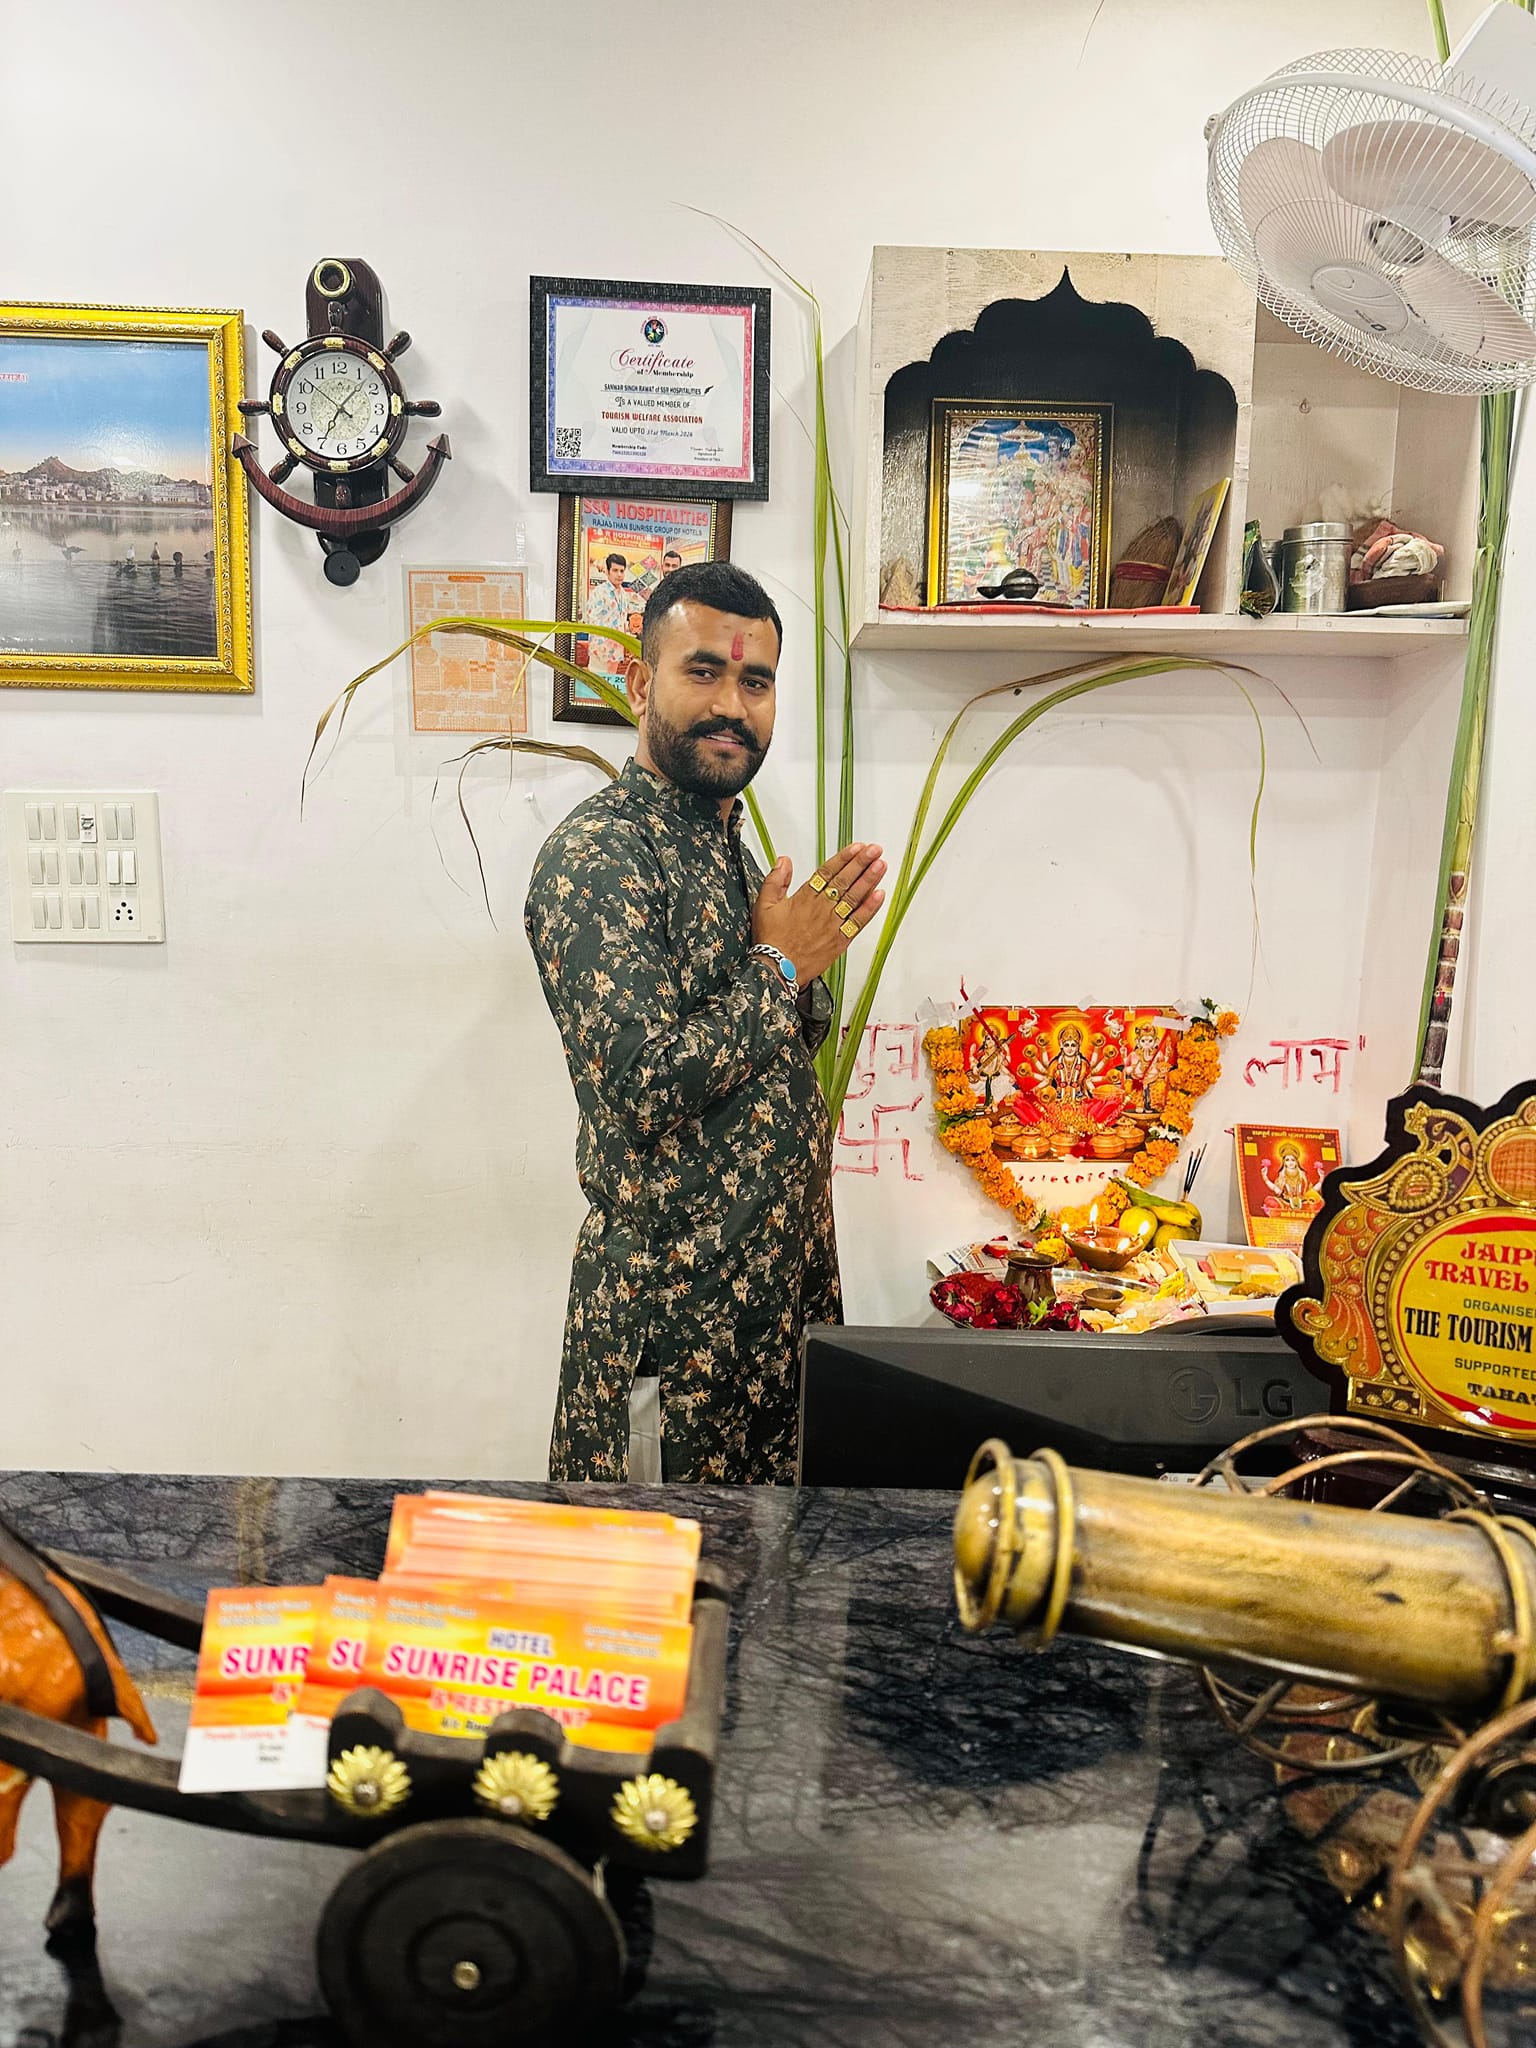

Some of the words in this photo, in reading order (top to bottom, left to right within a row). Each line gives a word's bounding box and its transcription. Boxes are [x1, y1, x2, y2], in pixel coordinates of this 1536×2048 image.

[331, 361, 348, 375] 12
[612, 348, 695, 374] Certificate
[315, 367, 325, 380] 11
[356, 367, 362, 380] 1
[652, 369, 694, 378] Membership
[298, 381, 314, 395] 10
[368, 382, 379, 396] 2
[296, 402, 307, 415] 9
[374, 403, 385, 416] 3
[633, 399, 655, 407] VALUED
[601, 411, 630, 421] TOURISM
[632, 412, 661, 422] WELFARE
[662, 414, 703, 424] ASSOCIATION
[302, 422, 314, 435] 8
[370, 424, 380, 436] 4
[611, 426, 628, 434] VALID
[629, 427, 645, 435] UPTO
[317, 437, 328, 450] 7
[336, 442, 348, 456] 6
[355, 438, 367, 450] 5
[583, 499, 611, 517] SSR
[615, 502, 709, 527] HOSPITALITIES
[592, 519, 628, 531] RAJASTHAN
[629, 523, 653, 533] SUNRISE
[654, 526, 673, 534] GROUP
[673, 527, 681, 535] OF
[682, 528, 702, 536] HOTELS
[1460, 1241, 1536, 1267] JAIP
[1424, 1260, 1529, 1293] TRAVEL
[1463, 1298, 1536, 1319] ORGANISE
[1404, 1307, 1441, 1338] THE
[1447, 1313, 1533, 1354] TOURISM
[1233, 1377, 1296, 1418] LG
[489, 1630, 551, 1656] HOTEL
[386, 1645, 520, 1689] SUNRISE
[529, 1665, 648, 1706] PALACE
